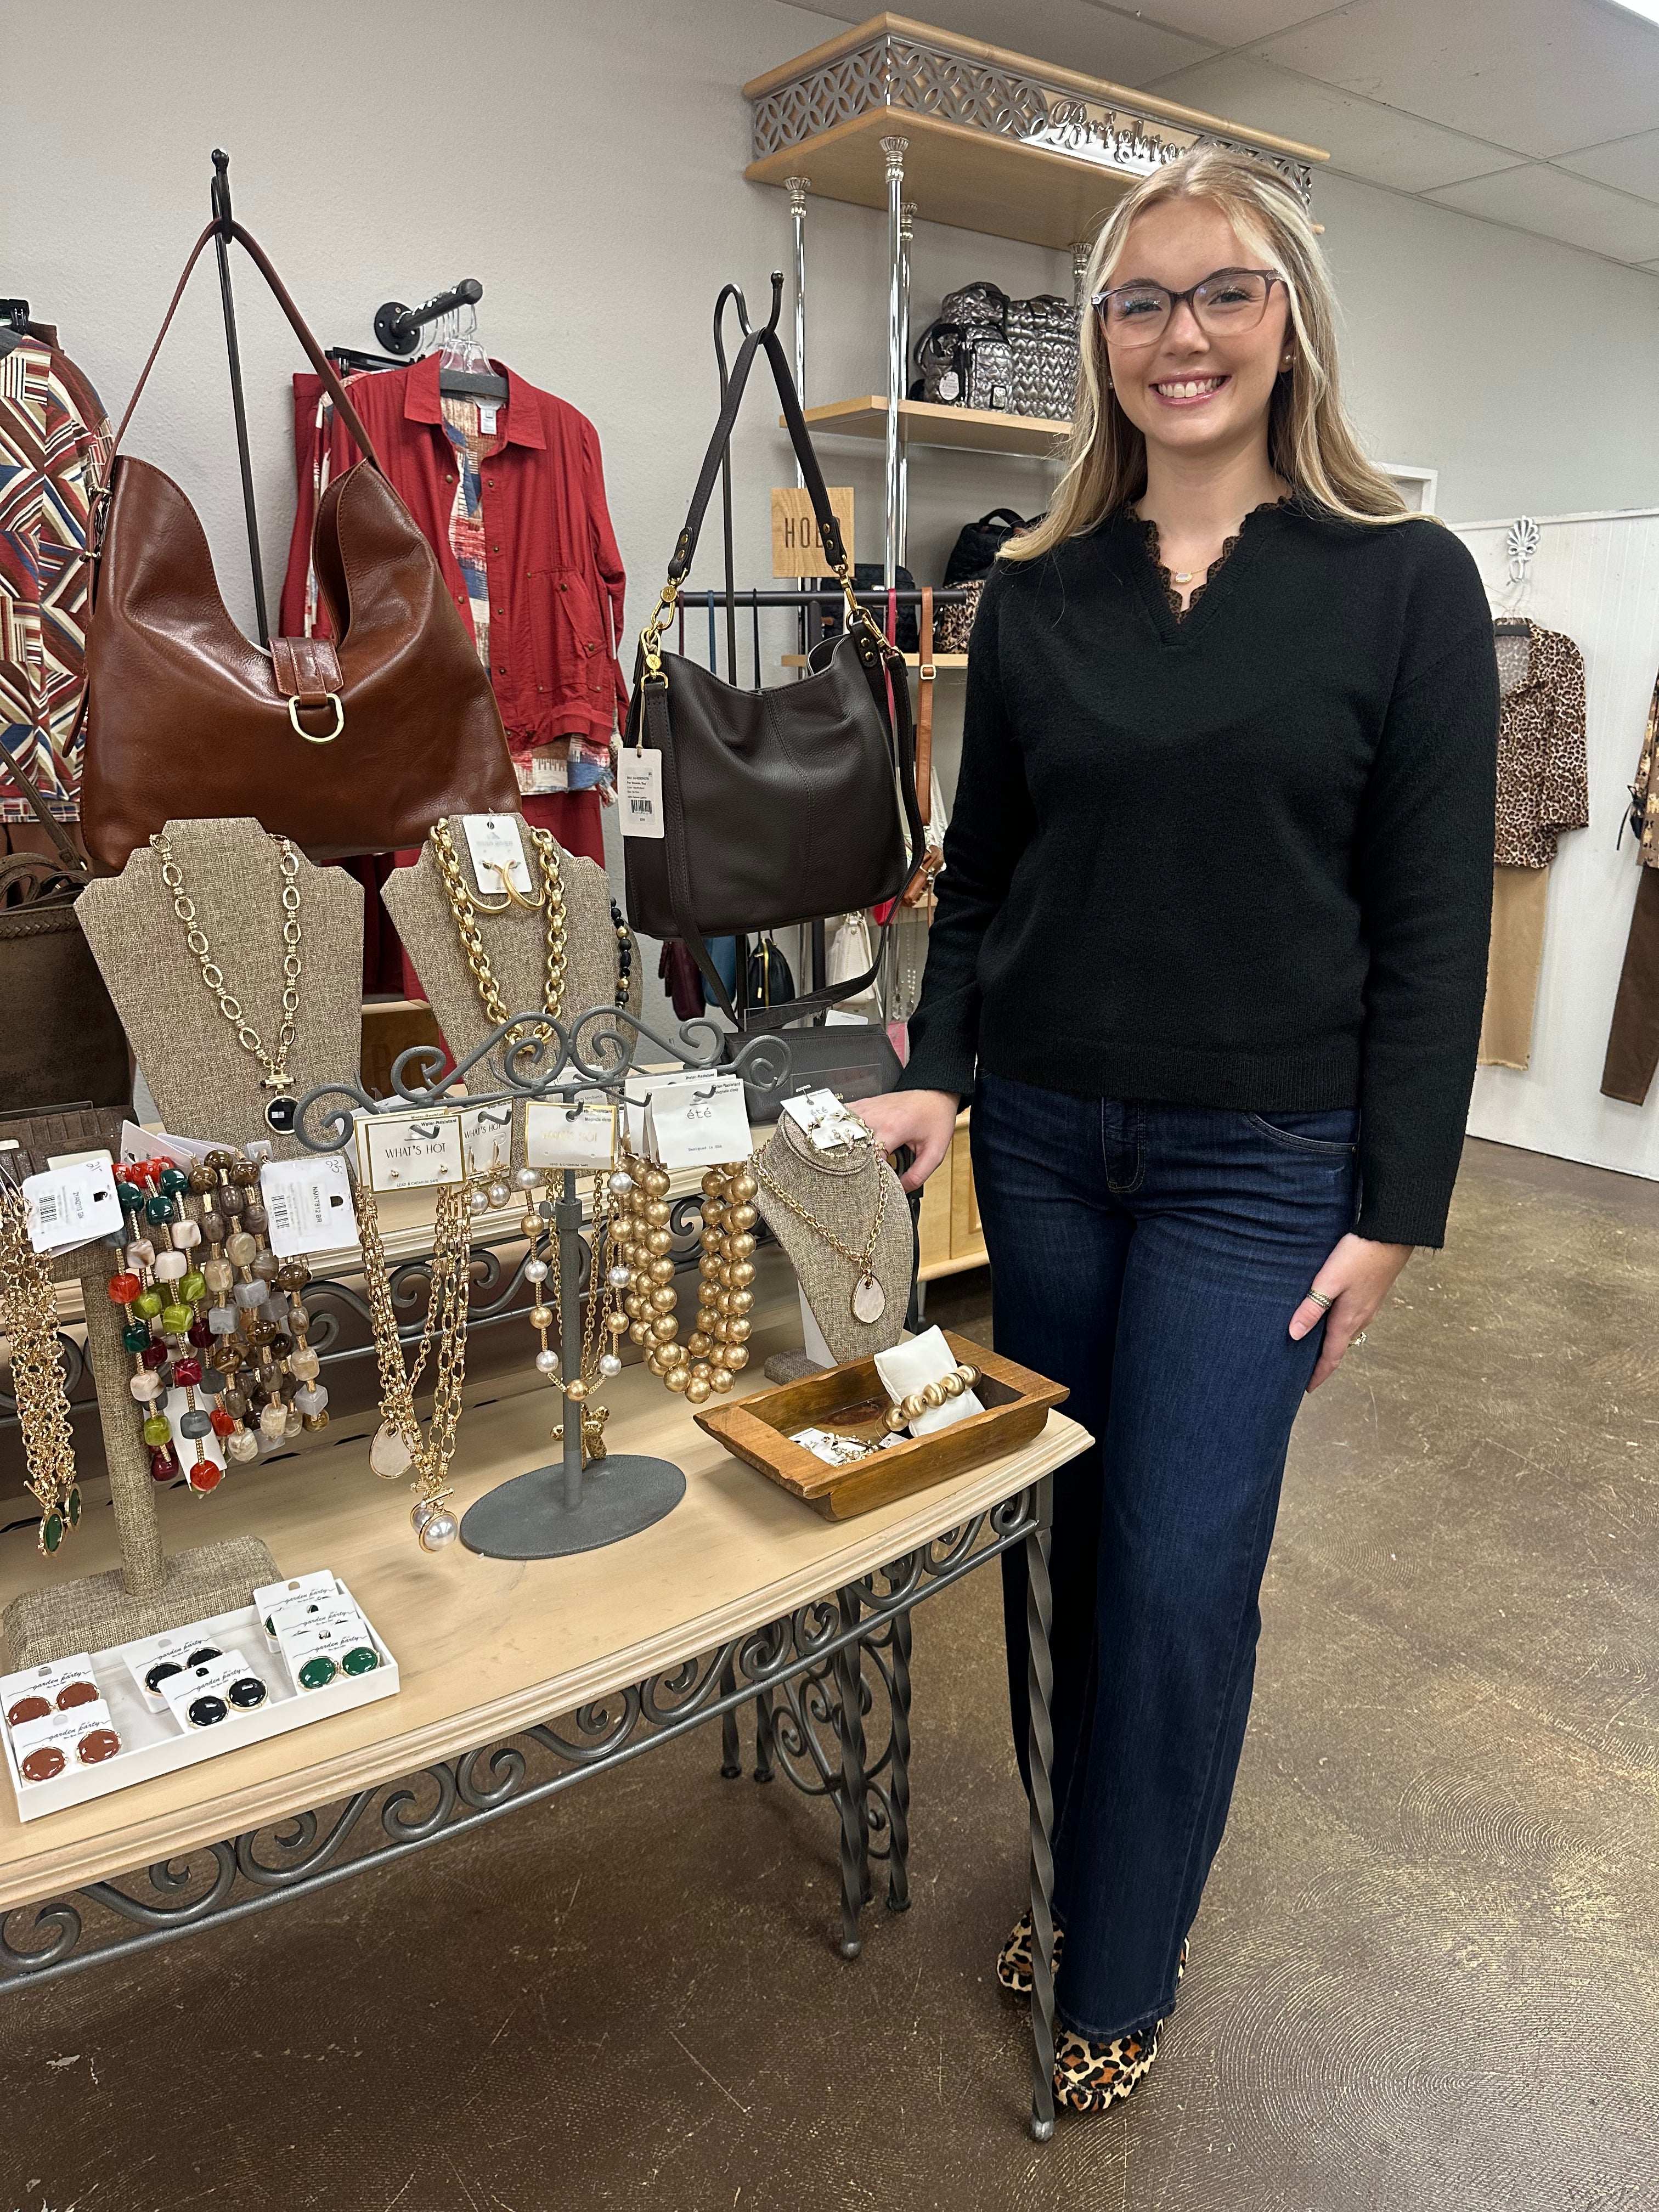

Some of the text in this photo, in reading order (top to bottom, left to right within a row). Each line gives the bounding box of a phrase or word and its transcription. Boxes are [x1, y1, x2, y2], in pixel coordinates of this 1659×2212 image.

[1049, 99, 1185, 164] Brighto
[785, 517, 840, 549] HO
[687, 1107, 712, 1120] été
[811, 1106, 828, 1116] été
[421, 1118, 457, 1127] Water-Resistant
[464, 1126, 487, 1139] WHAT'S
[385, 1142, 446, 1159] WHAT'S HOT
[312, 1186, 323, 1223] NMN7812 BR
[285, 1594, 307, 1604] garden
[309, 1588, 328, 1598] party
[303, 1616, 326, 1627] garden
[328, 1611, 347, 1621] party
[157, 1647, 182, 1661] garden
[184, 1639, 203, 1651] party
[315, 1641, 338, 1653] garden
[340, 1636, 360, 1645] party
[32, 1678, 59, 1691] garden
[60, 1672, 82, 1683] party
[196, 1677, 221, 1692] garden
[222, 1668, 241, 1680] party
[48, 1728, 76, 1741] garden
[78, 1721, 101, 1732] party
